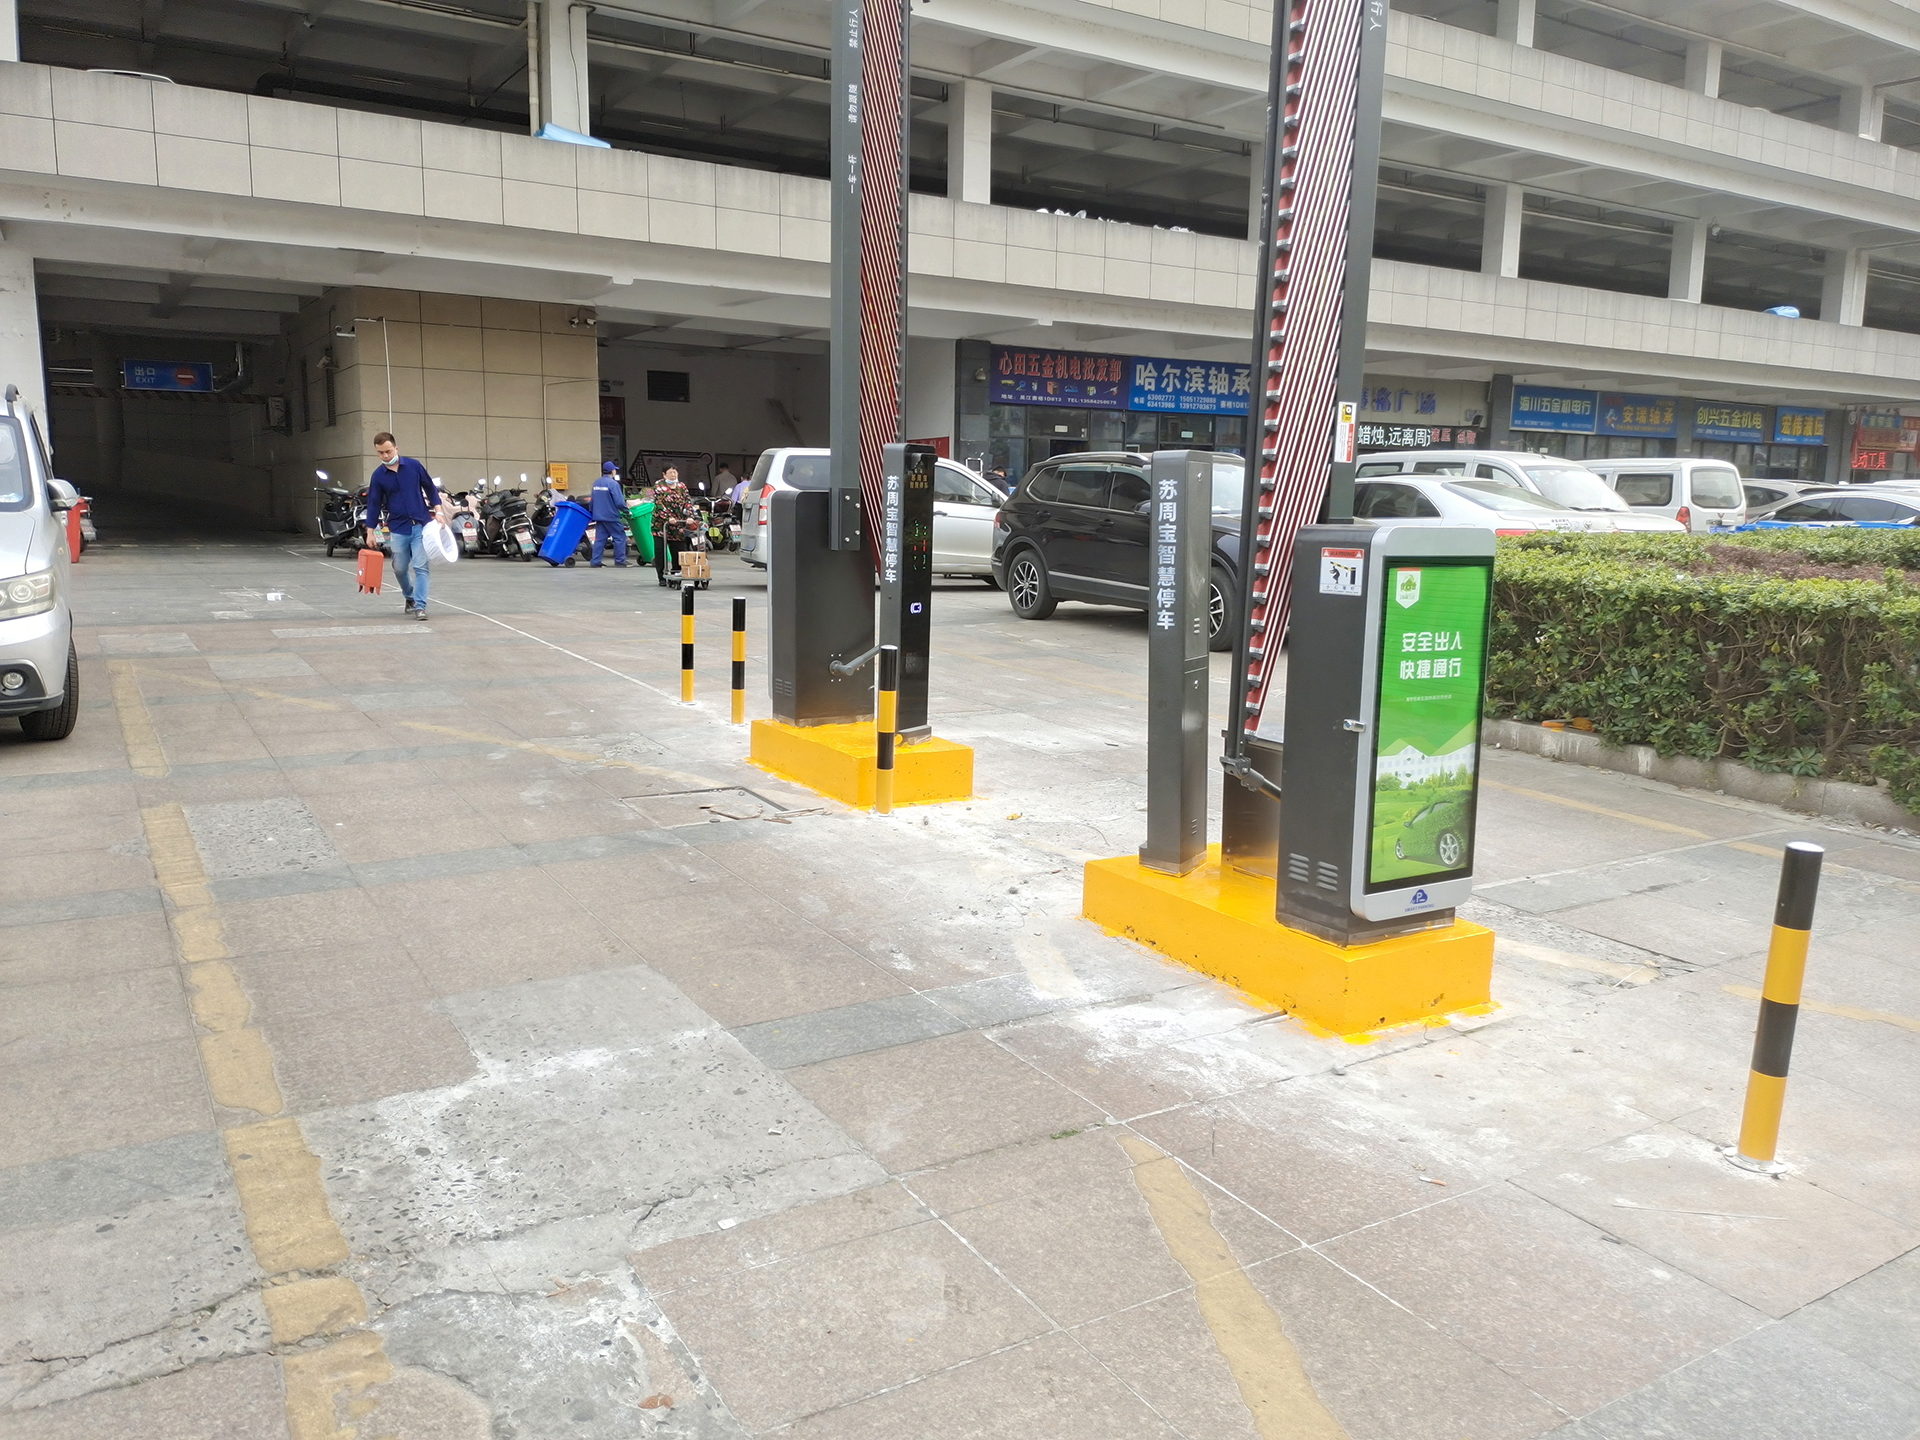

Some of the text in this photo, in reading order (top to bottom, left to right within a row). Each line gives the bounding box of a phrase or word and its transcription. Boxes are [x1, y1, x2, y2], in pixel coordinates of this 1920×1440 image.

[848, 8, 858, 194] 一车一杆 请勿跟随 禁止行人
[134, 366, 155, 376] 出口
[999, 351, 1122, 382] 心田五金机电批发部
[1136, 362, 1251, 396] 哈尔滨轴承
[1696, 407, 1763, 430] 创兴五金机电
[884, 475, 900, 584] 苏周宝智慧停车
[1157, 479, 1179, 630] 苏周宝智慧停车
[1401, 631, 1463, 652] 安全出入
[1400, 658, 1462, 680] 快捷通行
